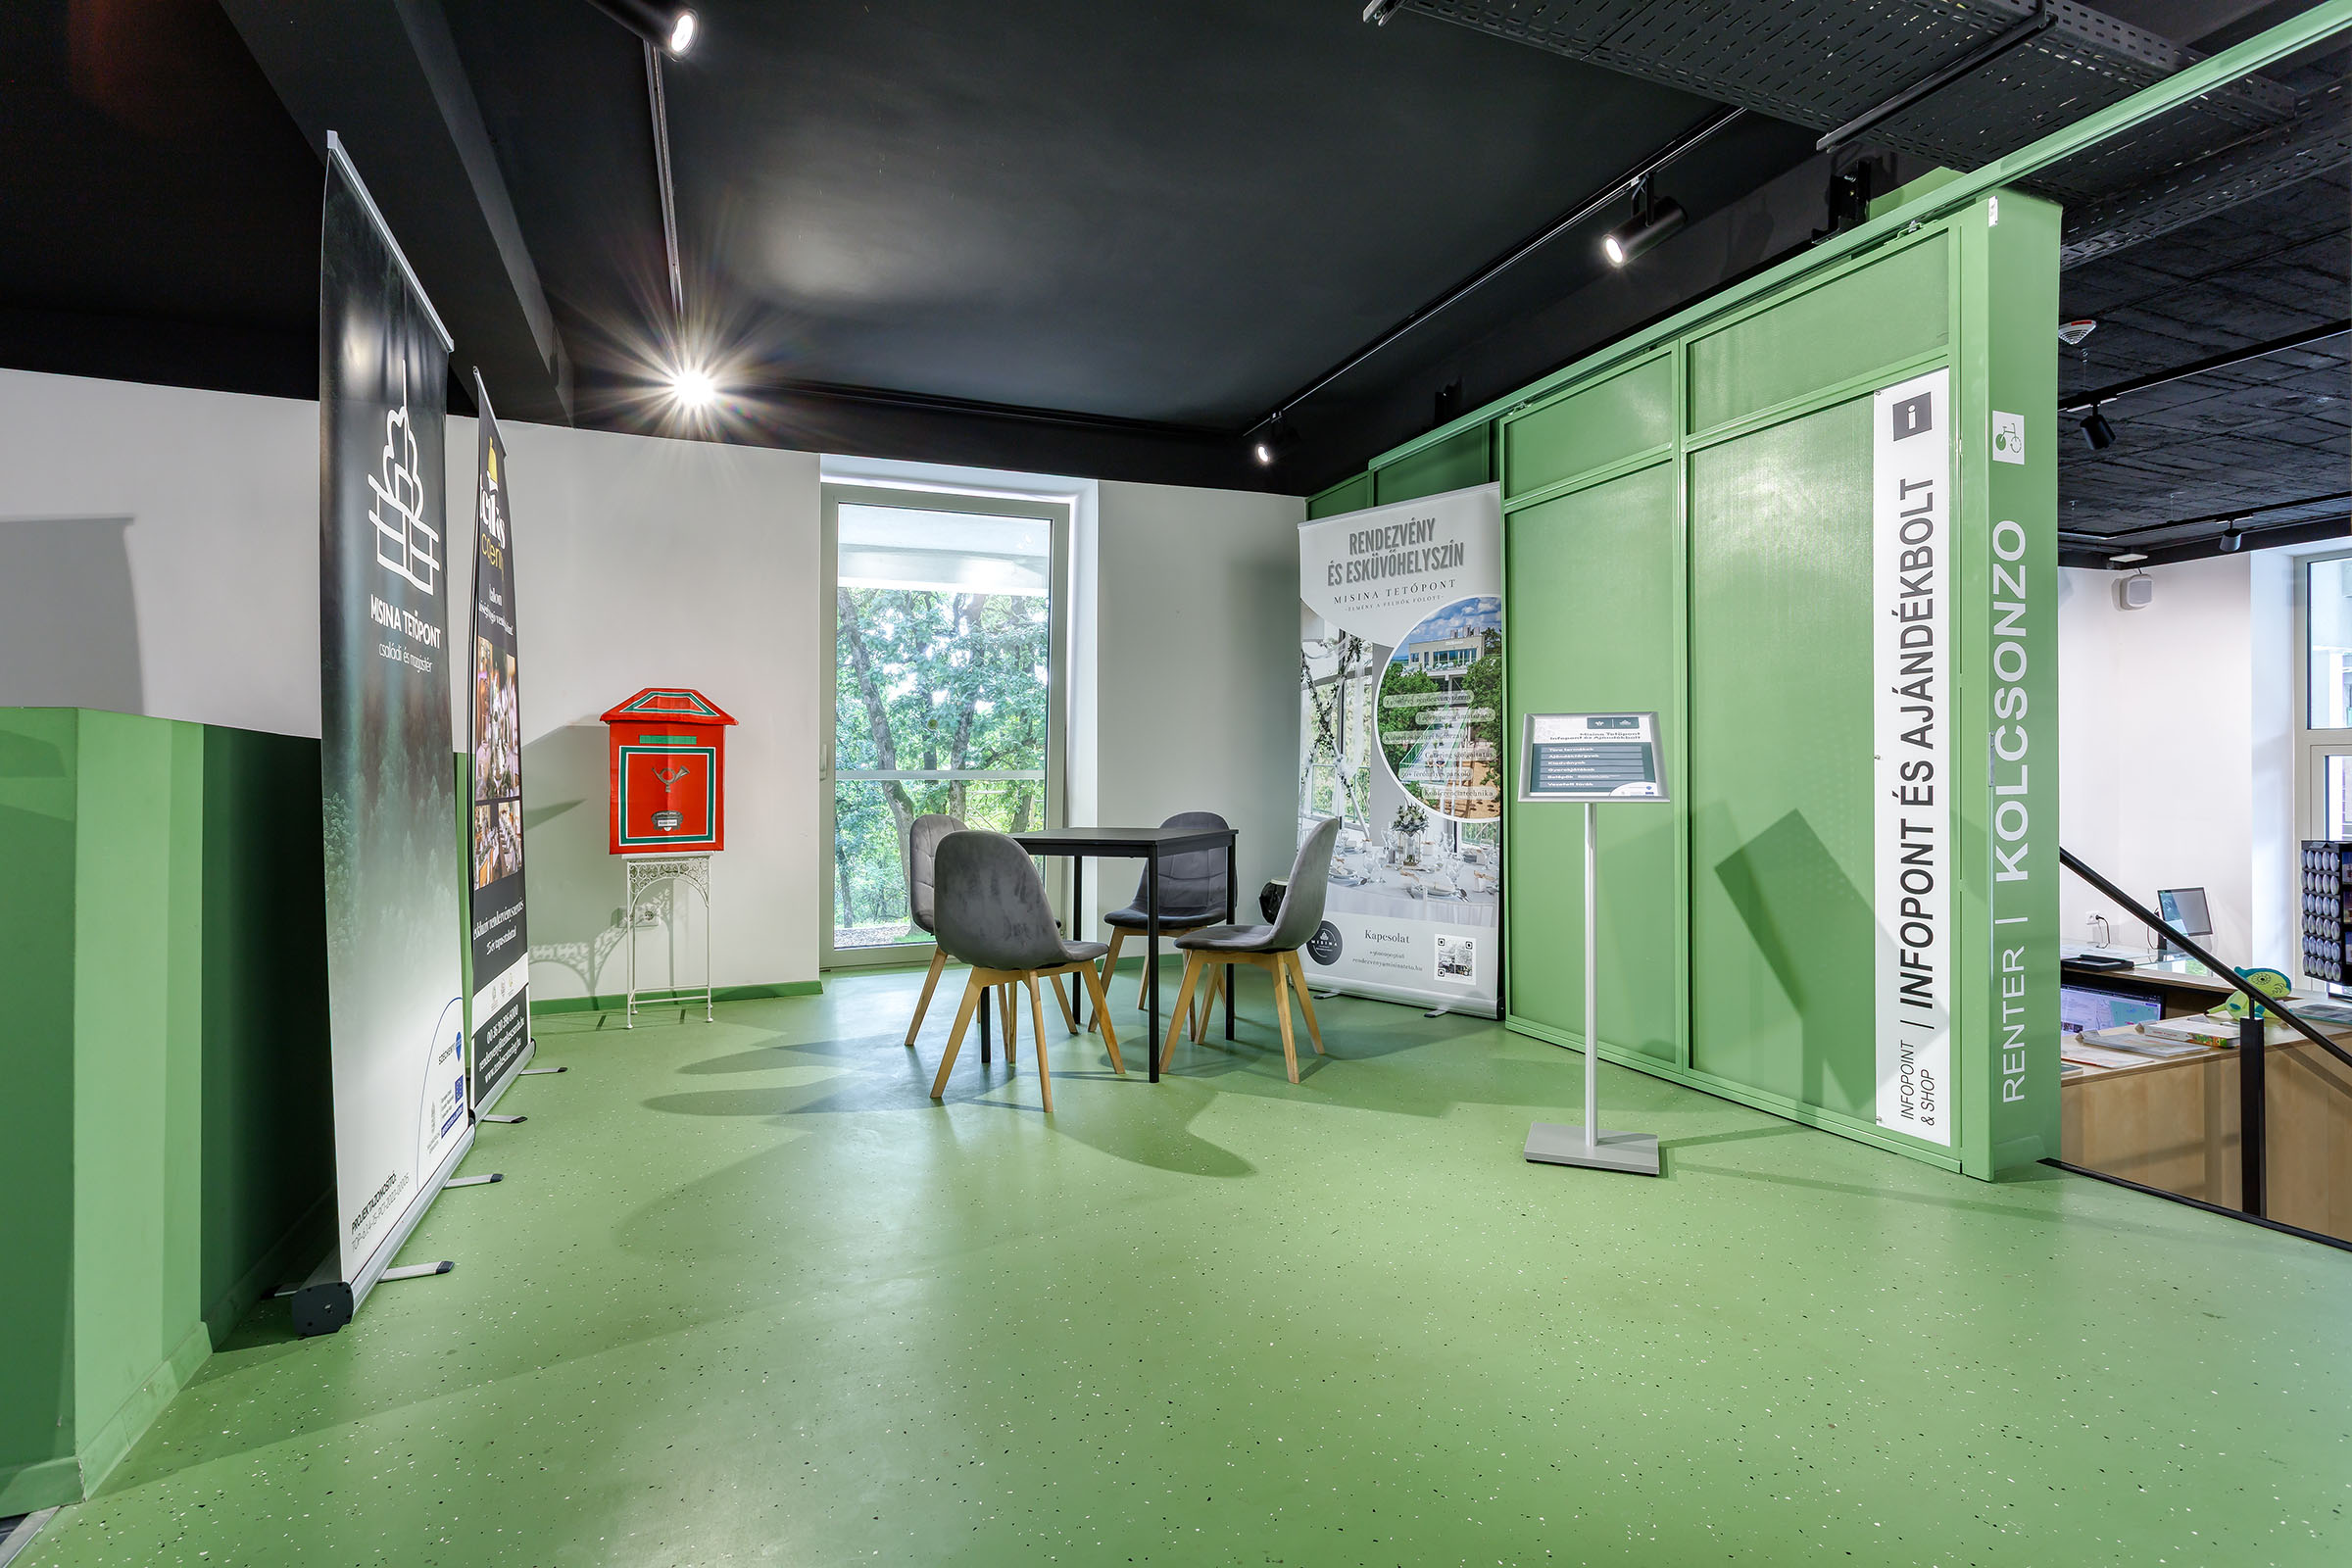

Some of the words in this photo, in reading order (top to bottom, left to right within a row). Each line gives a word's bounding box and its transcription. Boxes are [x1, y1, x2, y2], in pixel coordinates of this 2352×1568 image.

[1349, 517, 1436, 556] RENDEZVÉNY
[1327, 560, 1343, 586] ÉS
[1346, 539, 1464, 584] ESKÜVŐHELYSZÍN
[1334, 590, 1380, 604] MISINA
[1385, 578, 1457, 597] TETŐPONT
[1891, 478, 1935, 751] AJÁNDÉKBOLT
[370, 594, 402, 632] MISINA
[402, 610, 441, 649] TETŐPONT
[1891, 760, 1935, 807] ÉS
[1364, 929, 1410, 944] Kapcsolat
[1899, 818, 1935, 1009] INFOPONT
[2002, 946, 2025, 1102] RENTER
[1900, 1040, 1915, 1120] INFOPOINT
[1920, 1069, 1936, 1111] SHOP
[1920, 1116, 1936, 1126] &
